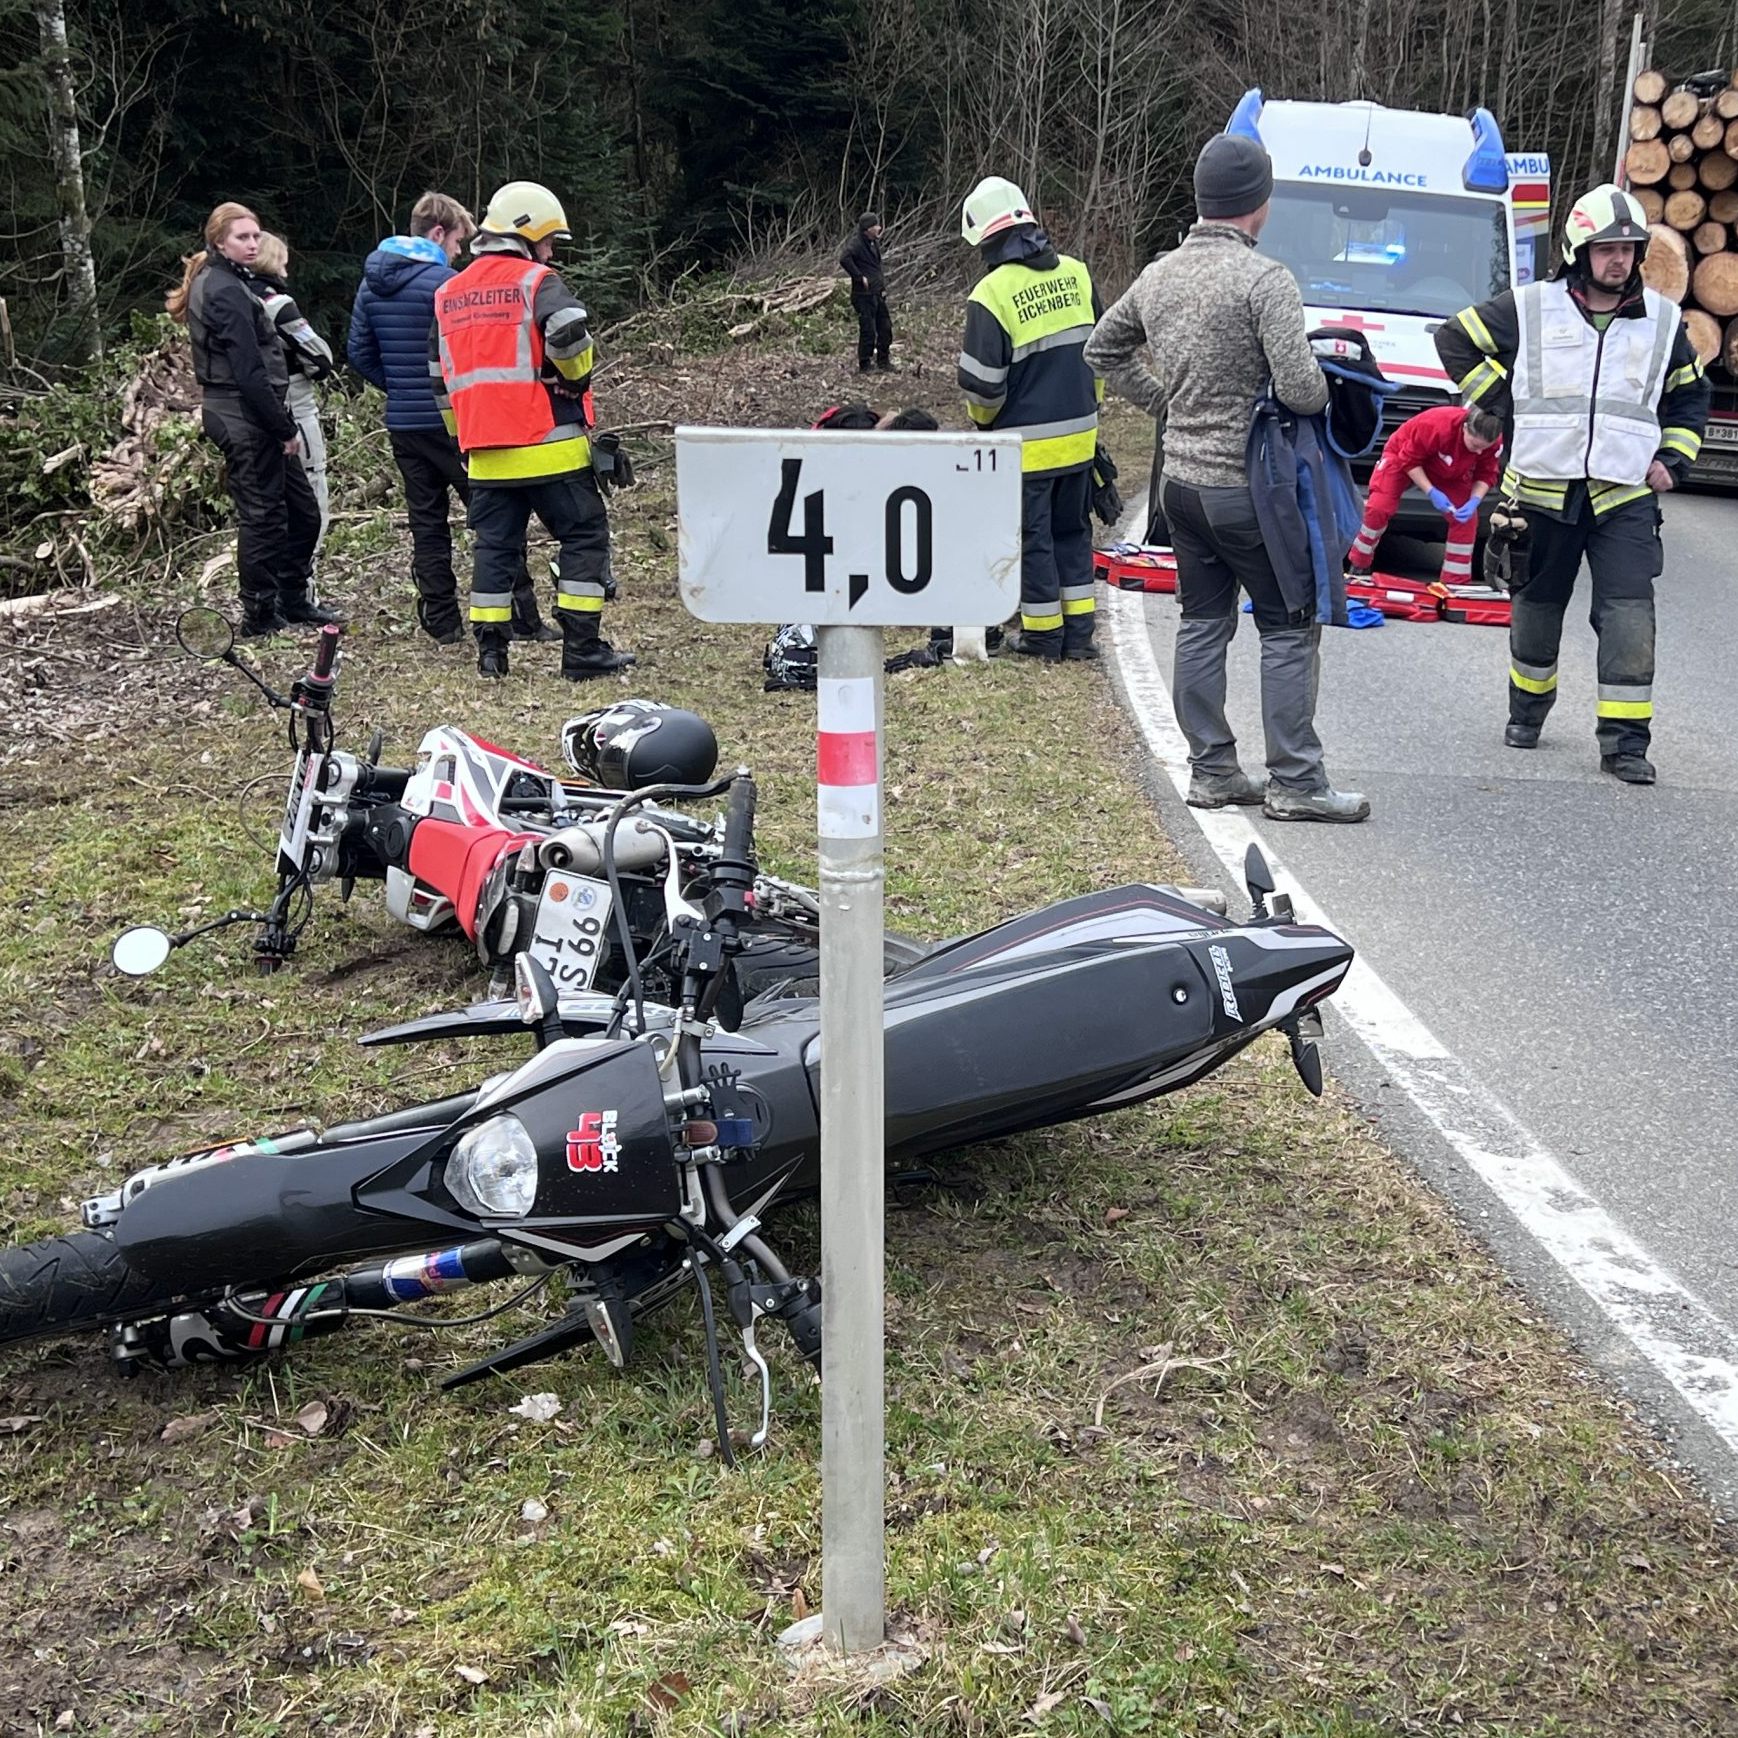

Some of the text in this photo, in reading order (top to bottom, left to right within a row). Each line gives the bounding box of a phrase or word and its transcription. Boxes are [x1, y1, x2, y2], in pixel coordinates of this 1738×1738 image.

[1298, 164, 1428, 188] AMBULANCE
[443, 288, 521, 314] EINSAZLEITER
[1012, 276, 1078, 309] FEUERWEHR
[1017, 292, 1081, 325] EICHENBERG
[767, 458, 933, 612] 4,0
